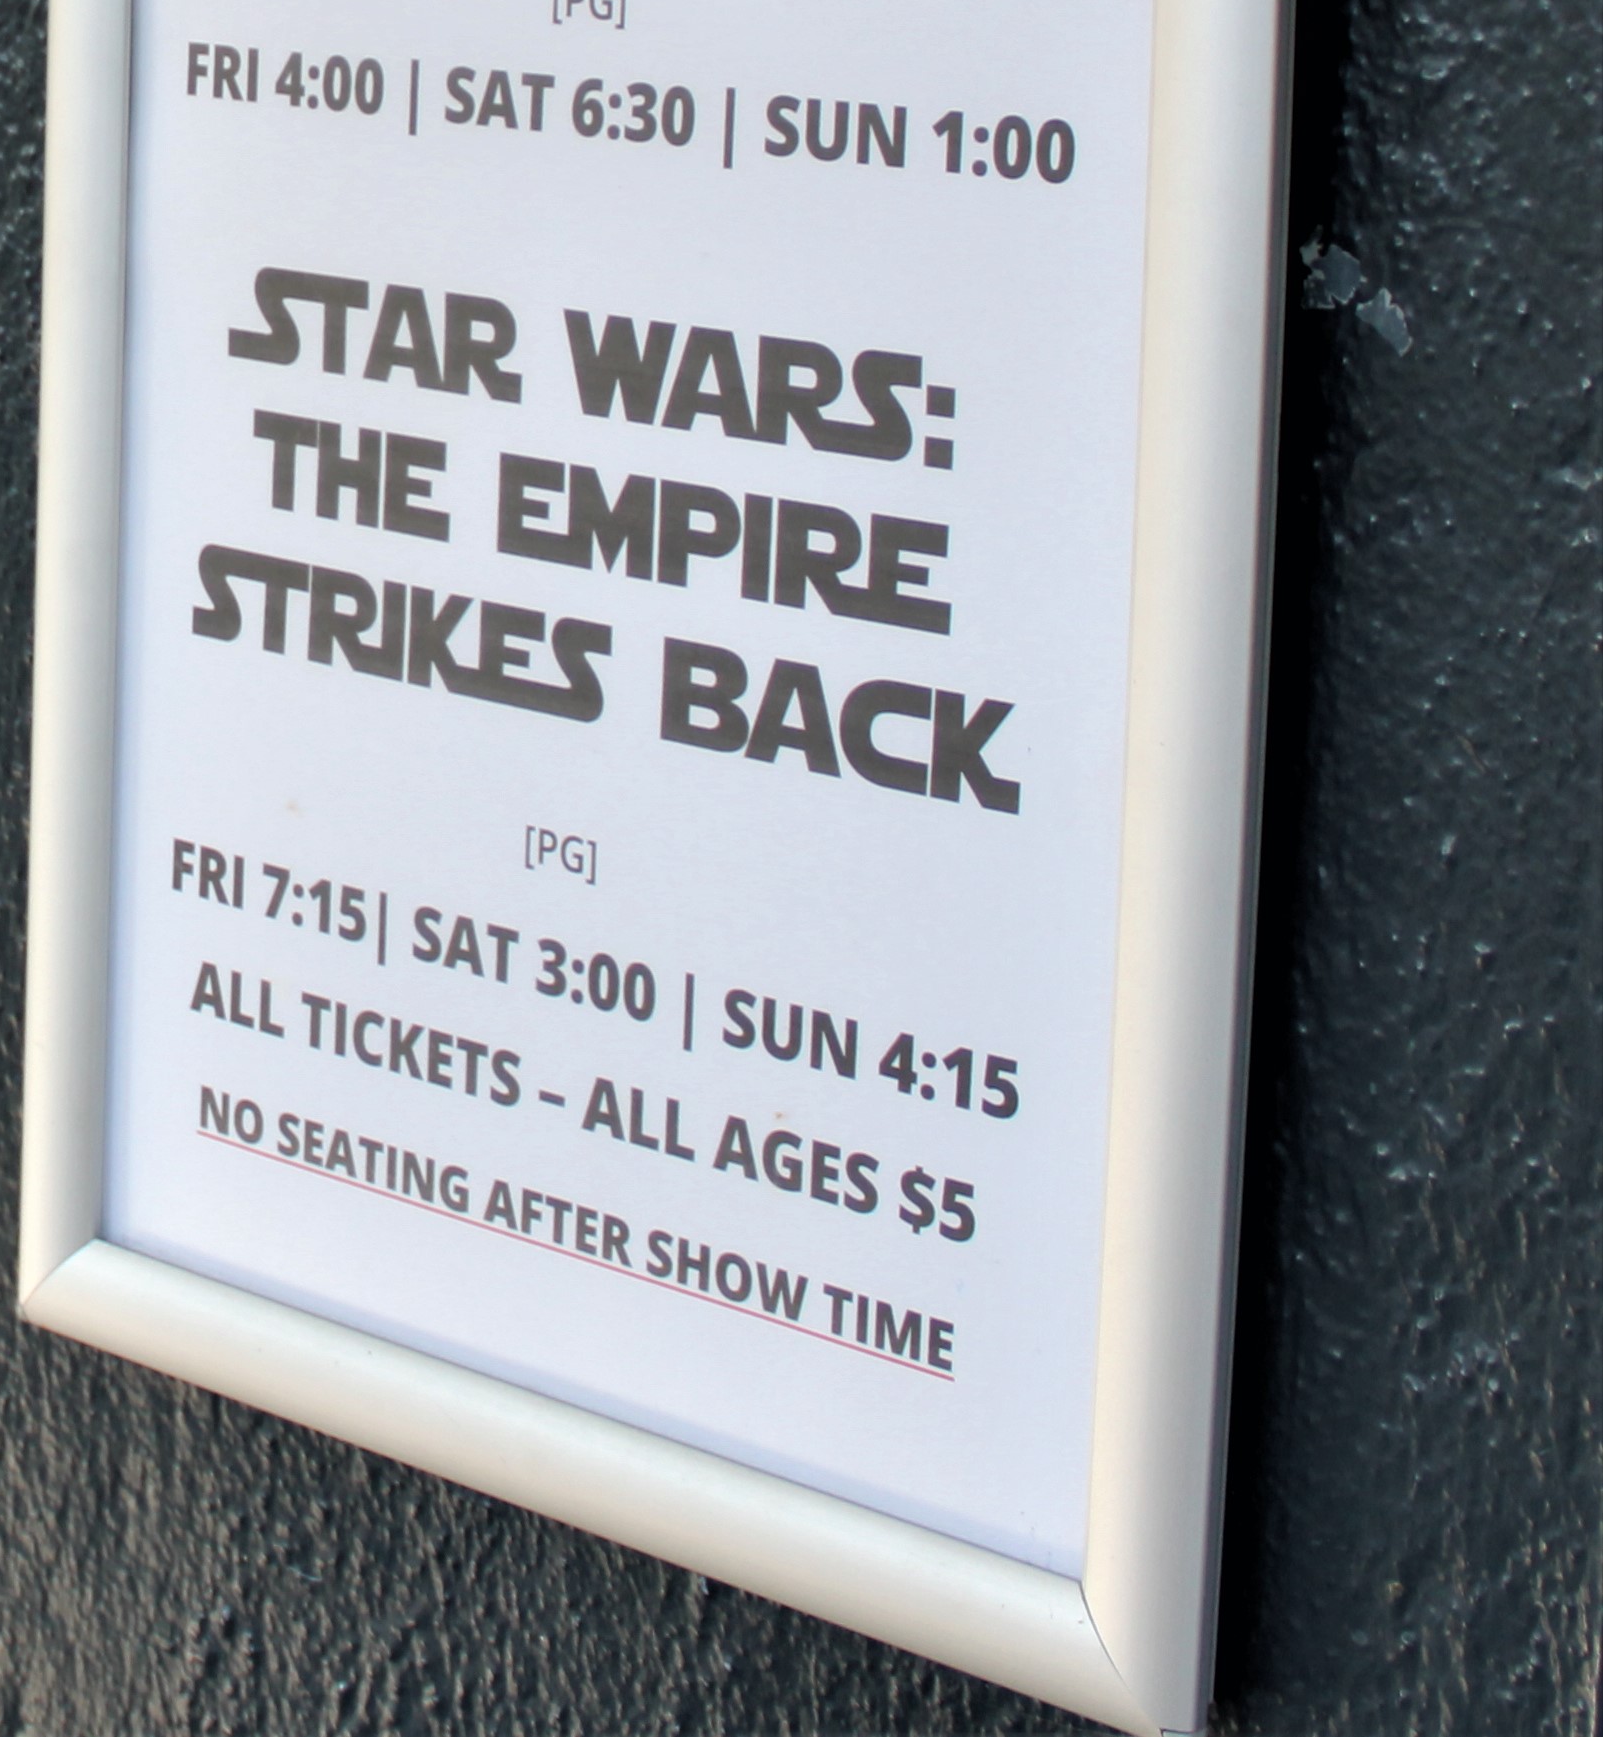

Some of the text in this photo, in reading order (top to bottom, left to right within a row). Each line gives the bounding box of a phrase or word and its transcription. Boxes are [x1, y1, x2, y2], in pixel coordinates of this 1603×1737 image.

[186, 42, 260, 103] FRI
[274, 51, 385, 116] 4:00
[444, 65, 556, 133] SAT
[571, 77, 696, 148] 6:30
[763, 94, 908, 169] SUN
[931, 110, 1076, 185] 1:00
[227, 266, 957, 471] STAR WARS:
[252, 408, 953, 637] THE EMPIRE
[191, 543, 1022, 816] STRIKES BACK
[171, 838, 245, 910] FRI
[412, 906, 520, 984] SAT
[535, 938, 657, 1023] 3:00
[722, 988, 859, 1081] SUN
[877, 1032, 1020, 1121] 4:15
[523, 825, 598, 886] [PG]
[190, 961, 285, 1038] ALL
[301, 992, 521, 1108] TICKETS
[581, 1076, 696, 1163] ALL
[712, 1115, 880, 1215] AGES
[898, 1163, 977, 1244] $5
[200, 1085, 955, 1373] NO SEATING AFTER SHOW TIME
